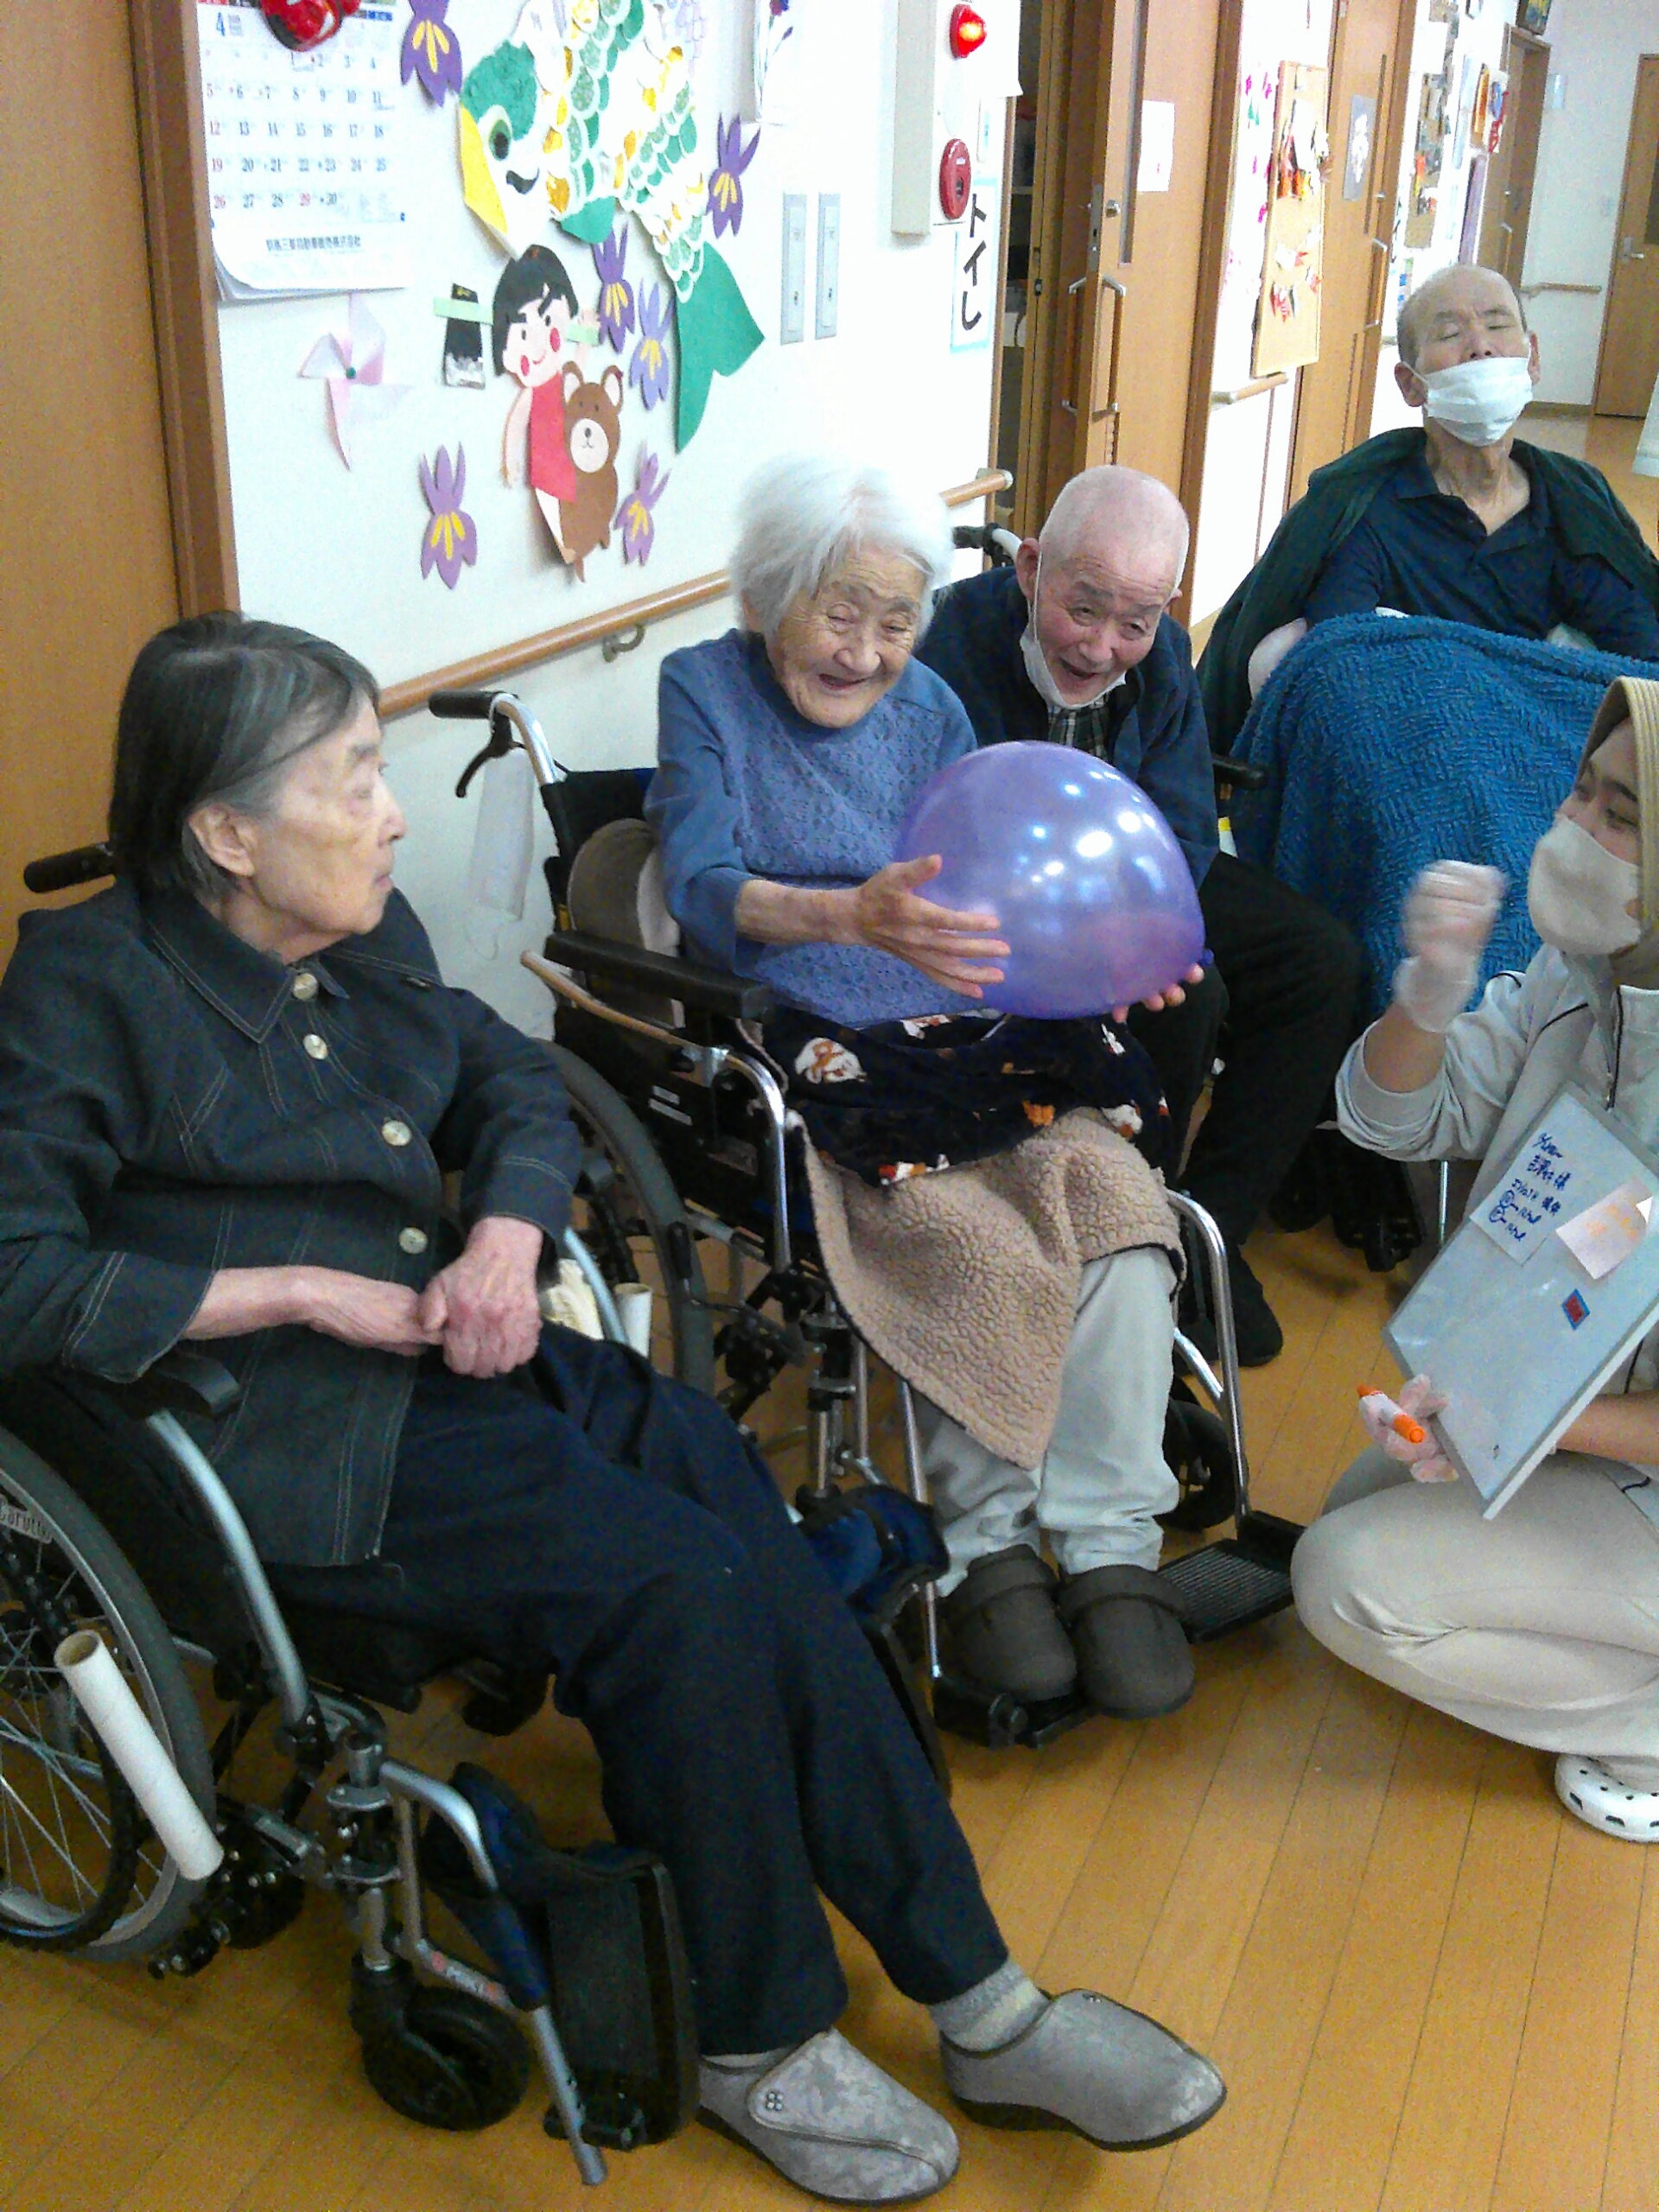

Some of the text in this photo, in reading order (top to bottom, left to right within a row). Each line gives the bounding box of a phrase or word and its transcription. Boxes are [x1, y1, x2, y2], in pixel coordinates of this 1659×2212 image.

[216, 11, 226, 36] 4
[236, 84, 245, 99] 6
[292, 86, 300, 101] 8
[319, 87, 327, 102] 9
[346, 89, 357, 104] 10
[372, 90, 383, 104] 11
[209, 120, 385, 138] 12 13 14 15 16 17 18
[212, 157, 387, 173] 19 20 21 22 23 24 25
[242, 193, 255, 209] 27
[270, 193, 284, 208] 28
[325, 192, 338, 207] 30
[962, 193, 988, 332] トイレ
